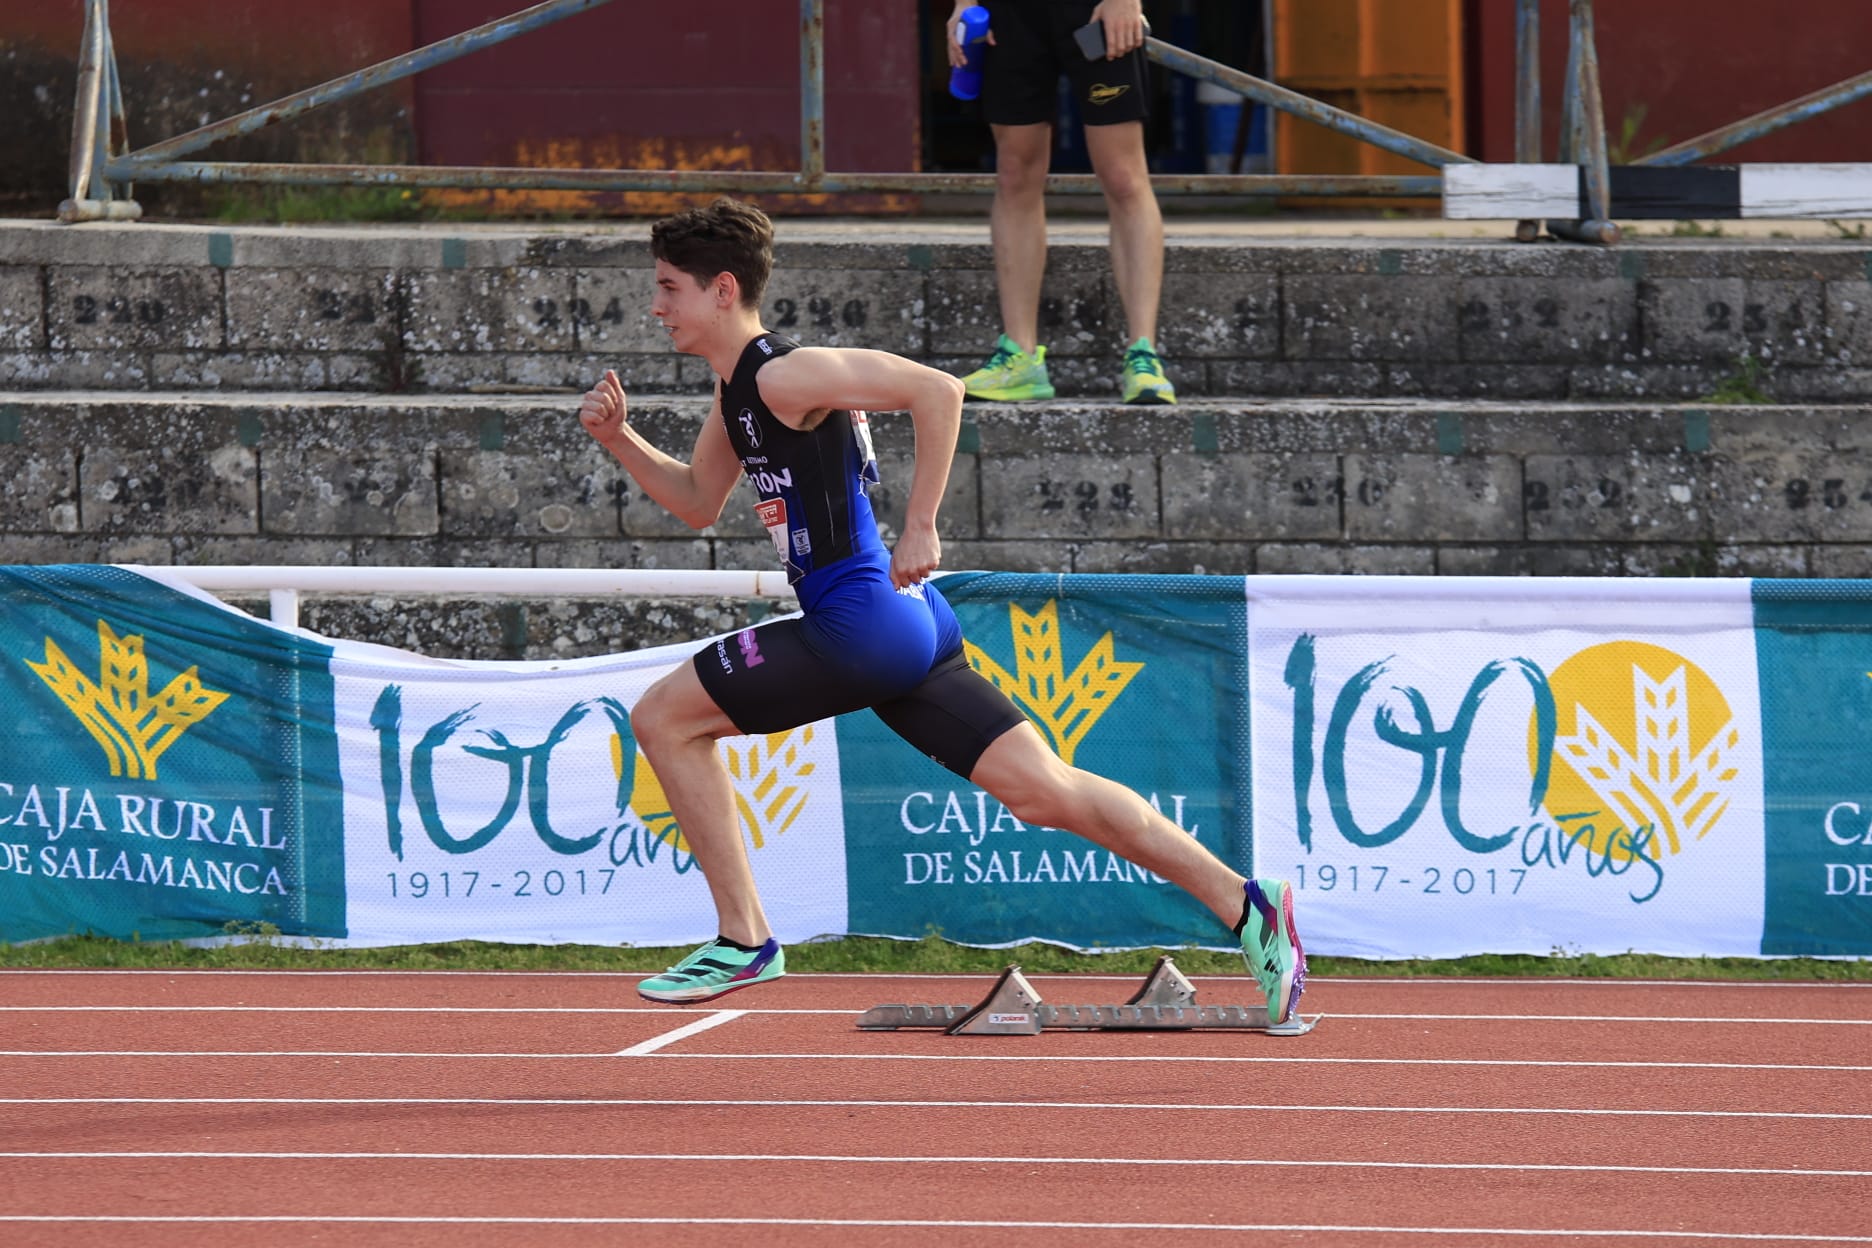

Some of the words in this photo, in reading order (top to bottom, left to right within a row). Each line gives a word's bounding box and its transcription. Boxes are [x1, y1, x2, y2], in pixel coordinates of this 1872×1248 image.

[1283, 632, 1558, 855] 100
[369, 682, 639, 863] 100
[116, 794, 287, 850] RURAL
[39, 846, 287, 895] SALAMANCA
[903, 852, 953, 885] DE
[964, 849, 1172, 885] SALAMAN
[1296, 864, 1528, 896] 1917-2017
[1520, 809, 1664, 904] años
[387, 868, 616, 898] 1917-2017
